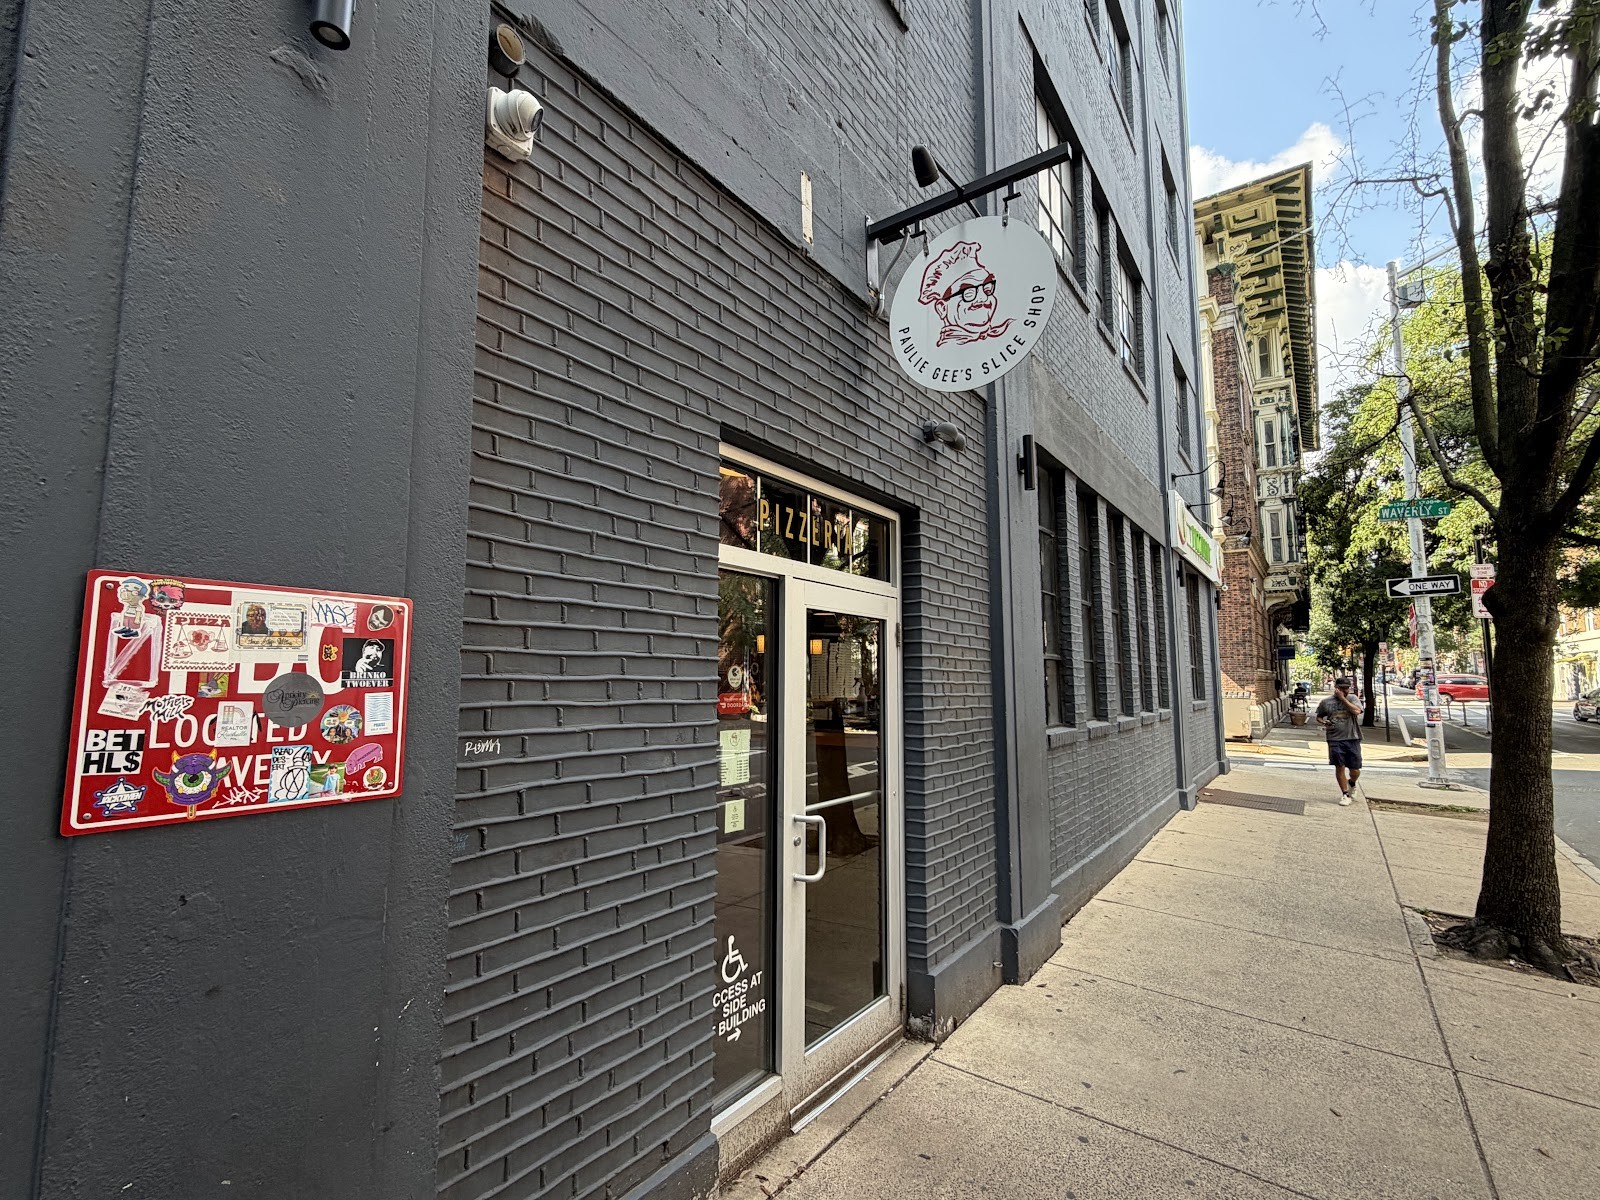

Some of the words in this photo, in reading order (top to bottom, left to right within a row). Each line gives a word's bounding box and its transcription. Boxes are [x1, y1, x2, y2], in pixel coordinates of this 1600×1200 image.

[899, 326, 929, 374] PAULIE
[932, 367, 972, 383] GEE'S
[982, 335, 1025, 374] SLICE
[1023, 285, 1046, 328] SHOP
[1381, 504, 1432, 519] WAVERLY
[1438, 506, 1448, 515] ST
[759, 498, 853, 555] PIZZERIA
[1408, 581, 1428, 591] ONE
[1431, 580, 1451, 589] WAY
[174, 616, 231, 627] PIZZA
[345, 680, 389, 688] TWOEVER
[349, 671, 387, 679] BRINKO
[85, 729, 145, 751] BET
[82, 751, 141, 774] HL$
[712, 979, 749, 1008] CCESS
[750, 970, 763, 989] AT
[722, 993, 747, 1018] SIDE
[718, 998, 766, 1037] BUILDING
